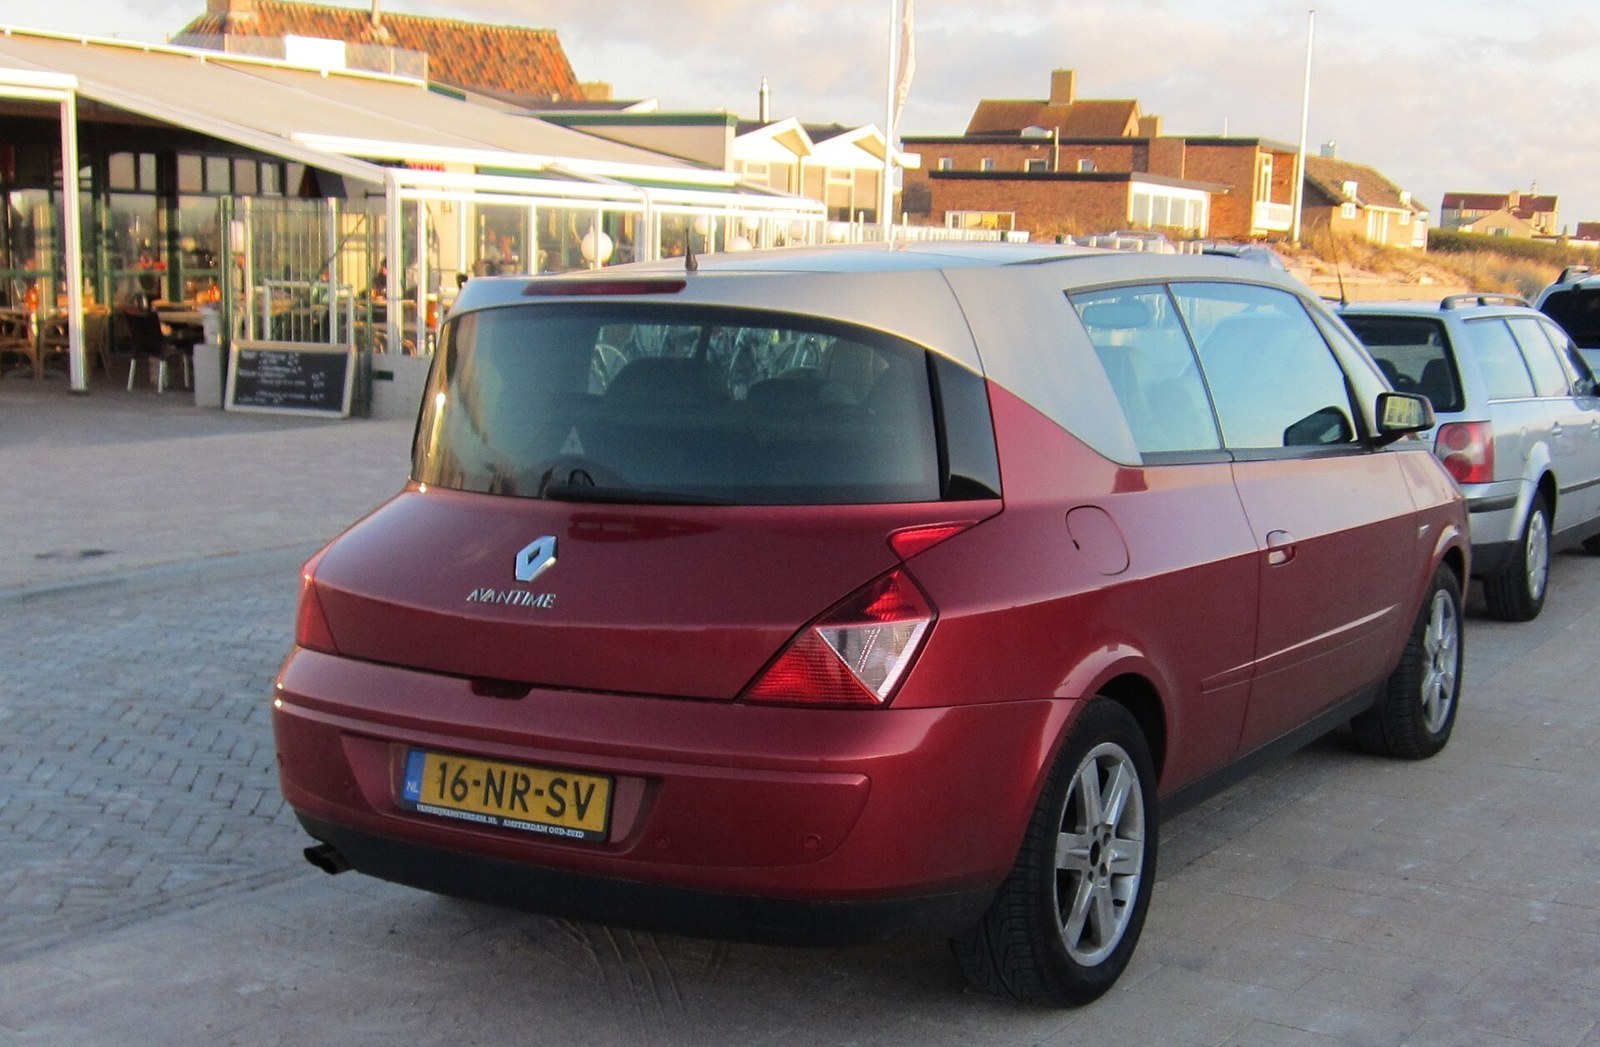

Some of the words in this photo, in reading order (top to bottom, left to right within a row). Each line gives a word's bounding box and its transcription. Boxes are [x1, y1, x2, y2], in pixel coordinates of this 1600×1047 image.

[466, 588, 556, 608] AVANTIME
[406, 781, 419, 793] NL
[438, 761, 596, 821] 16-NR-SV
[503, 818, 547, 833] AMSTERDAM
